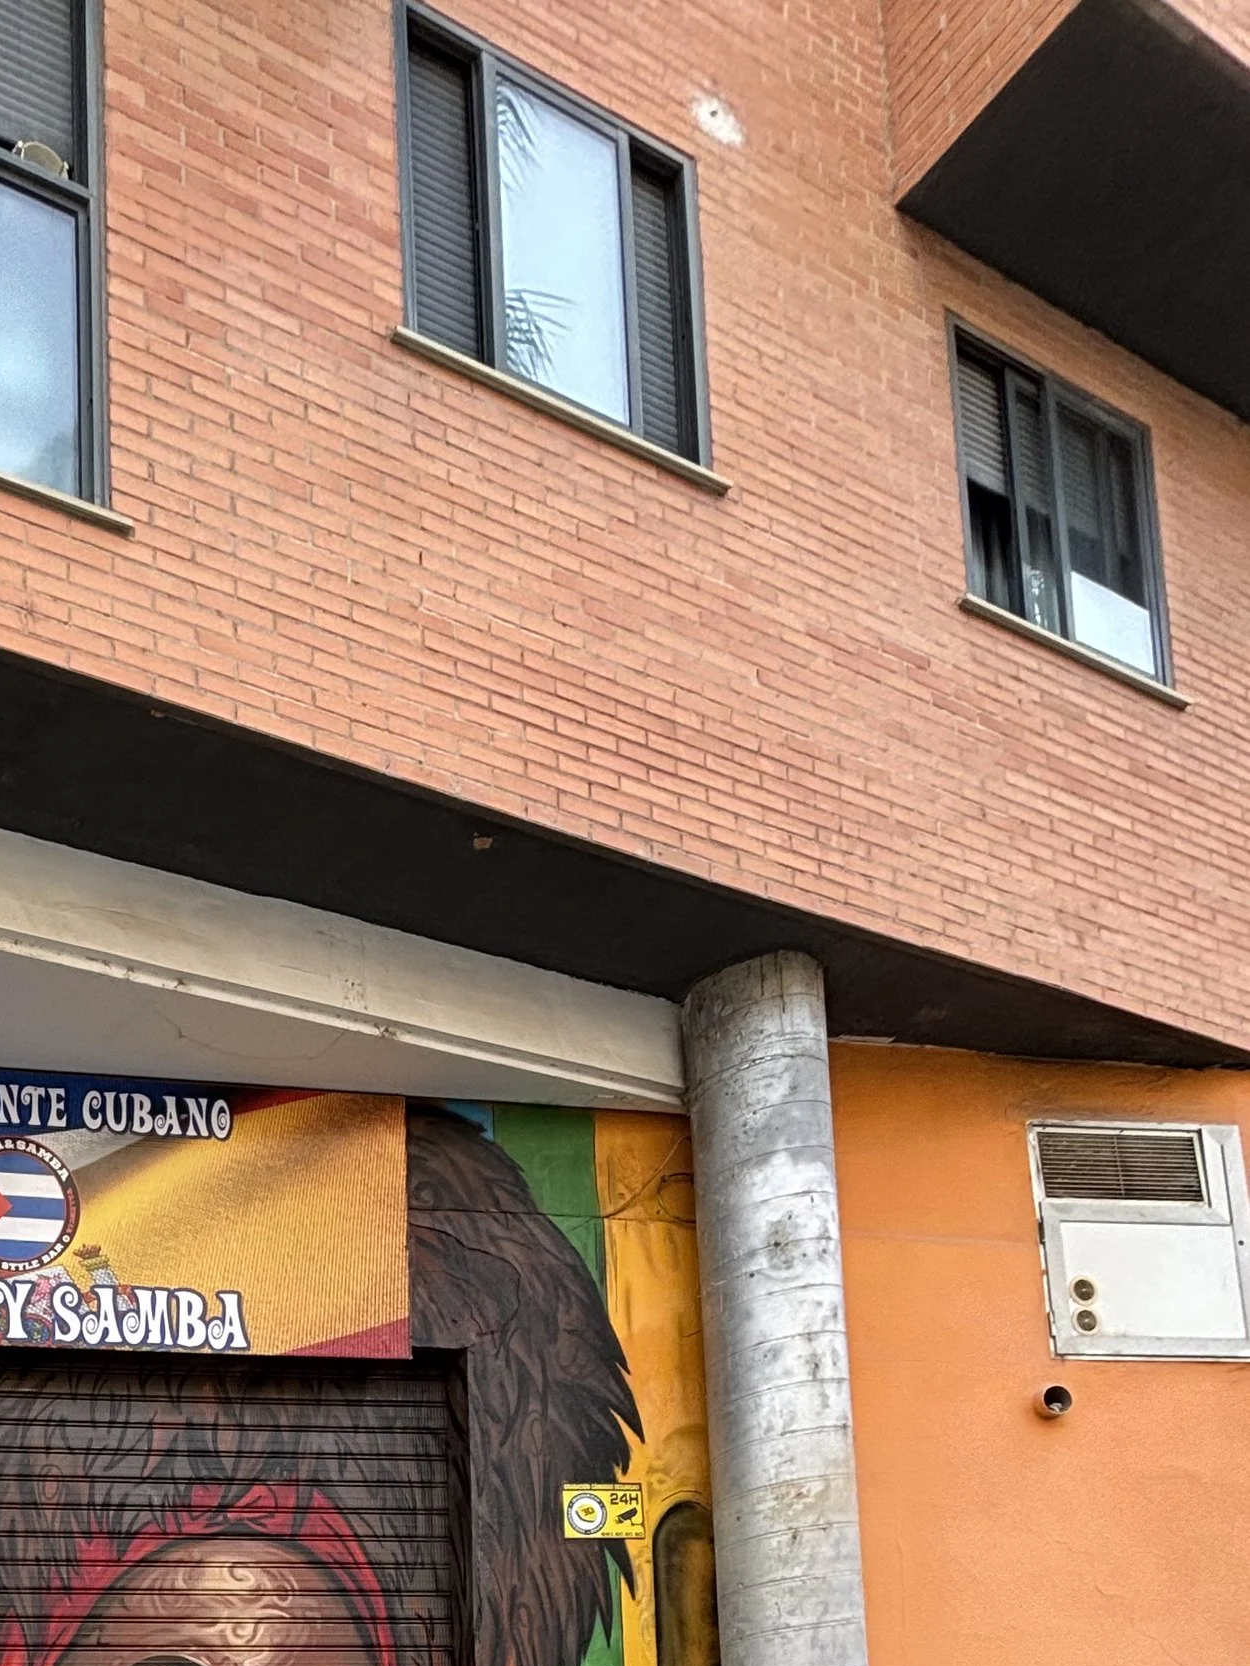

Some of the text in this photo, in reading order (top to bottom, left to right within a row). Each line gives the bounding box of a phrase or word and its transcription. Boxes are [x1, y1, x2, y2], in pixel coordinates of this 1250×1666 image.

[82, 1089, 231, 1139] CUBANO
[1, 1257, 41, 1271] STYLE
[41, 1243, 65, 1263] BAR
[52, 1287, 248, 1350] SAMBA
[609, 1492, 639, 1506] 24H
